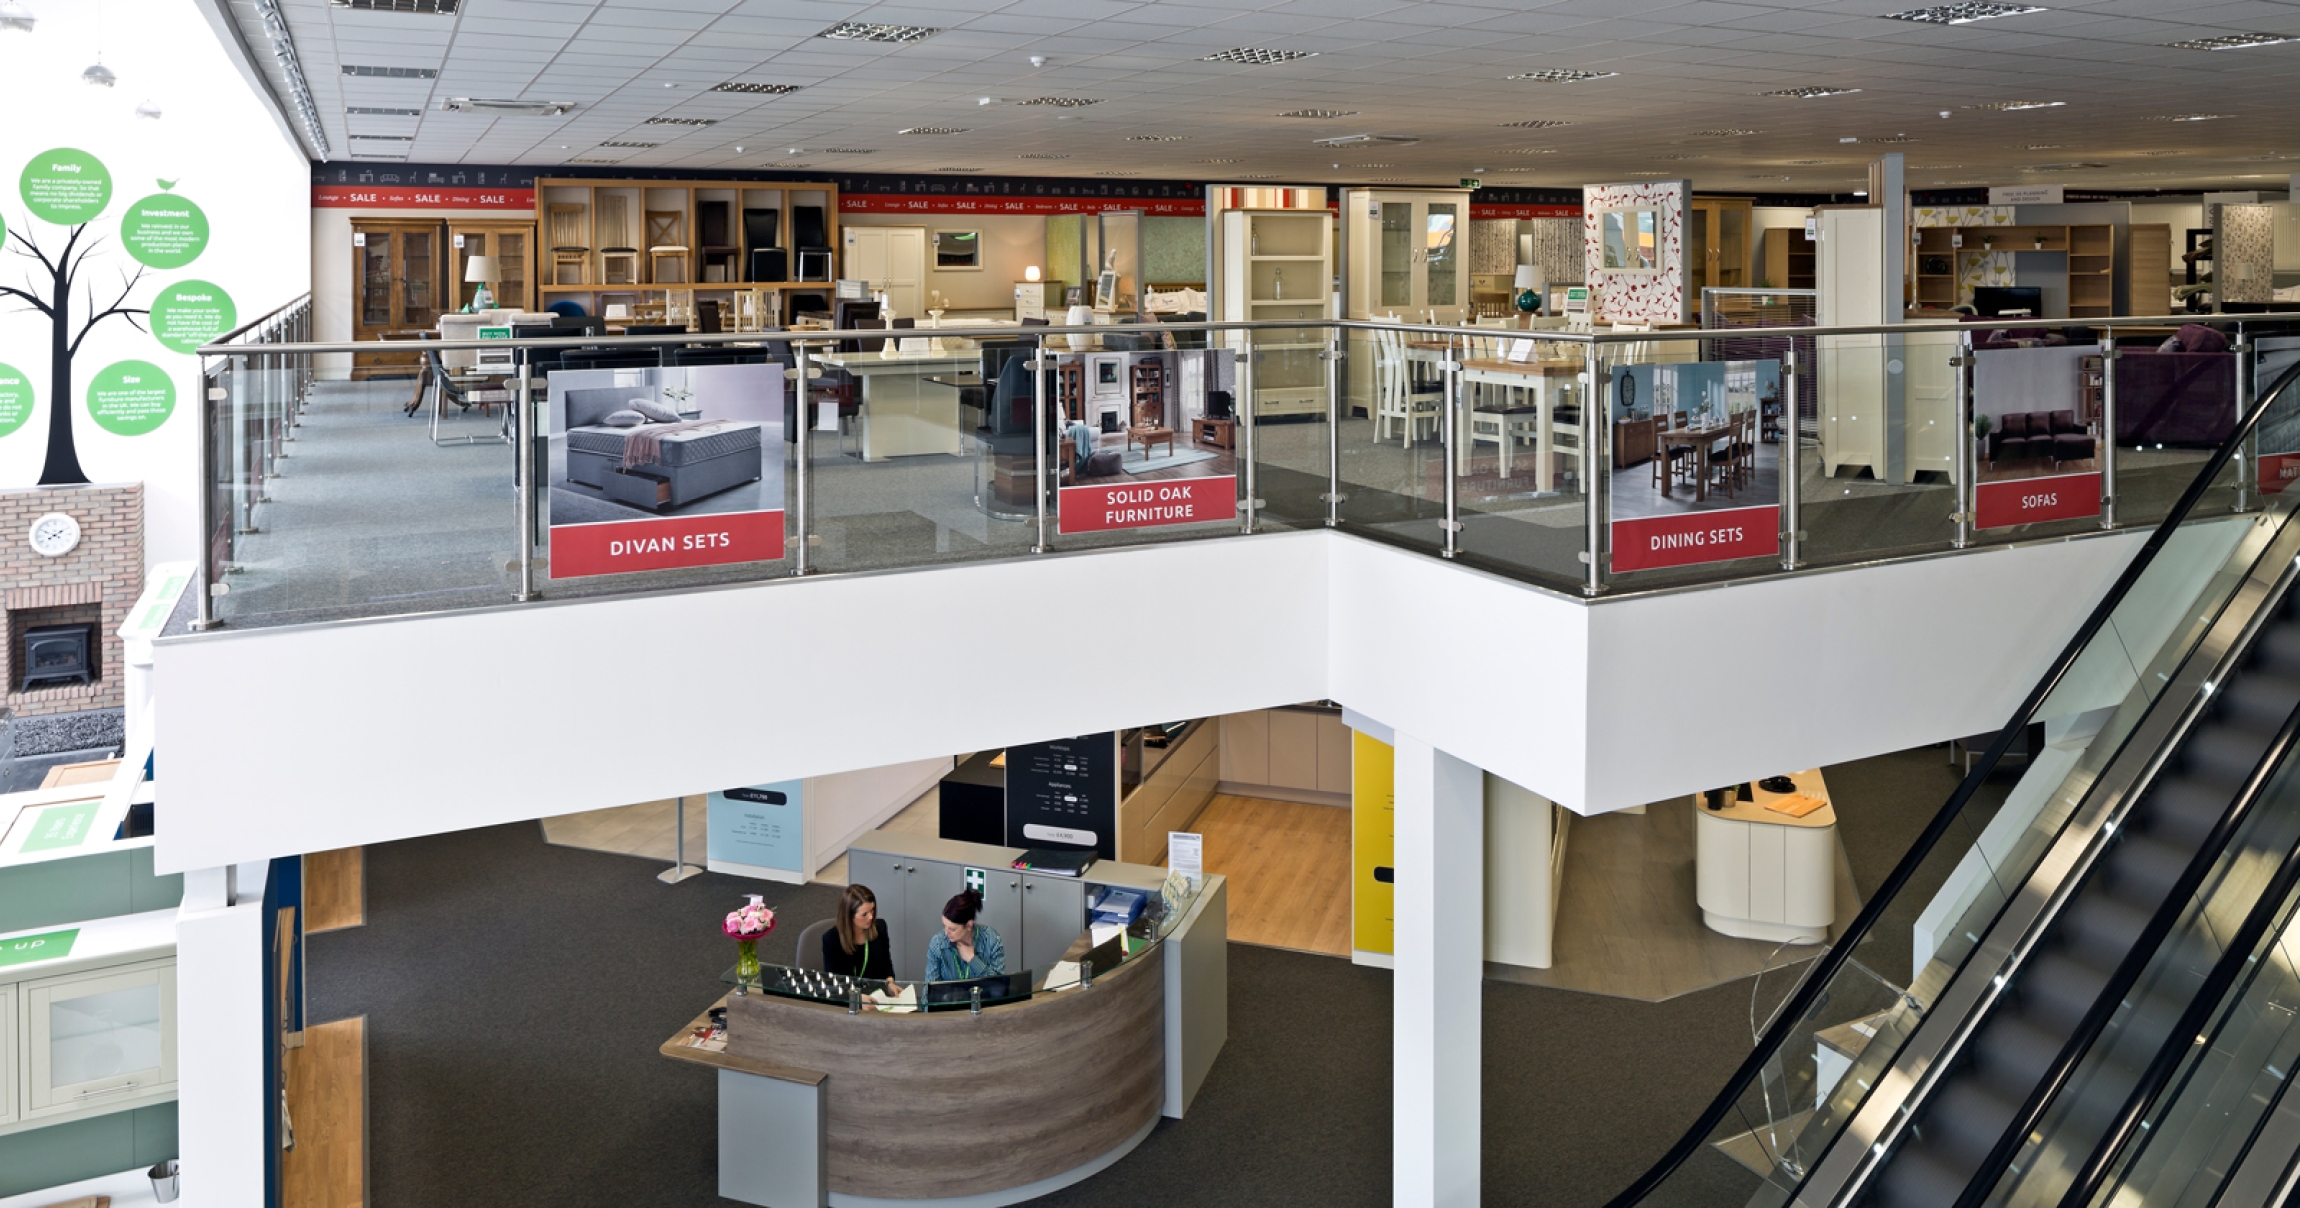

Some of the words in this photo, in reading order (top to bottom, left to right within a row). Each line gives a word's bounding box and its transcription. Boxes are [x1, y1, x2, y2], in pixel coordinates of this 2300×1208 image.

[52, 163, 81, 173] Family
[350, 194, 377, 202] SALE
[415, 194, 441, 203] SALE
[908, 201, 928, 209] SALE
[141, 209, 190, 218] Investment
[176, 293, 212, 302] Bespoke
[123, 375, 140, 384] Size
[1107, 489, 1154, 505] SOLID
[1159, 486, 1192, 500] OAK
[2022, 492, 2058, 509] SOFAS
[1106, 504, 1194, 524] FURNITURE
[610, 537, 676, 556] DIVAN
[683, 532, 730, 550] SETS
[1651, 531, 1704, 551] DINING
[1709, 527, 1743, 544] SETS
